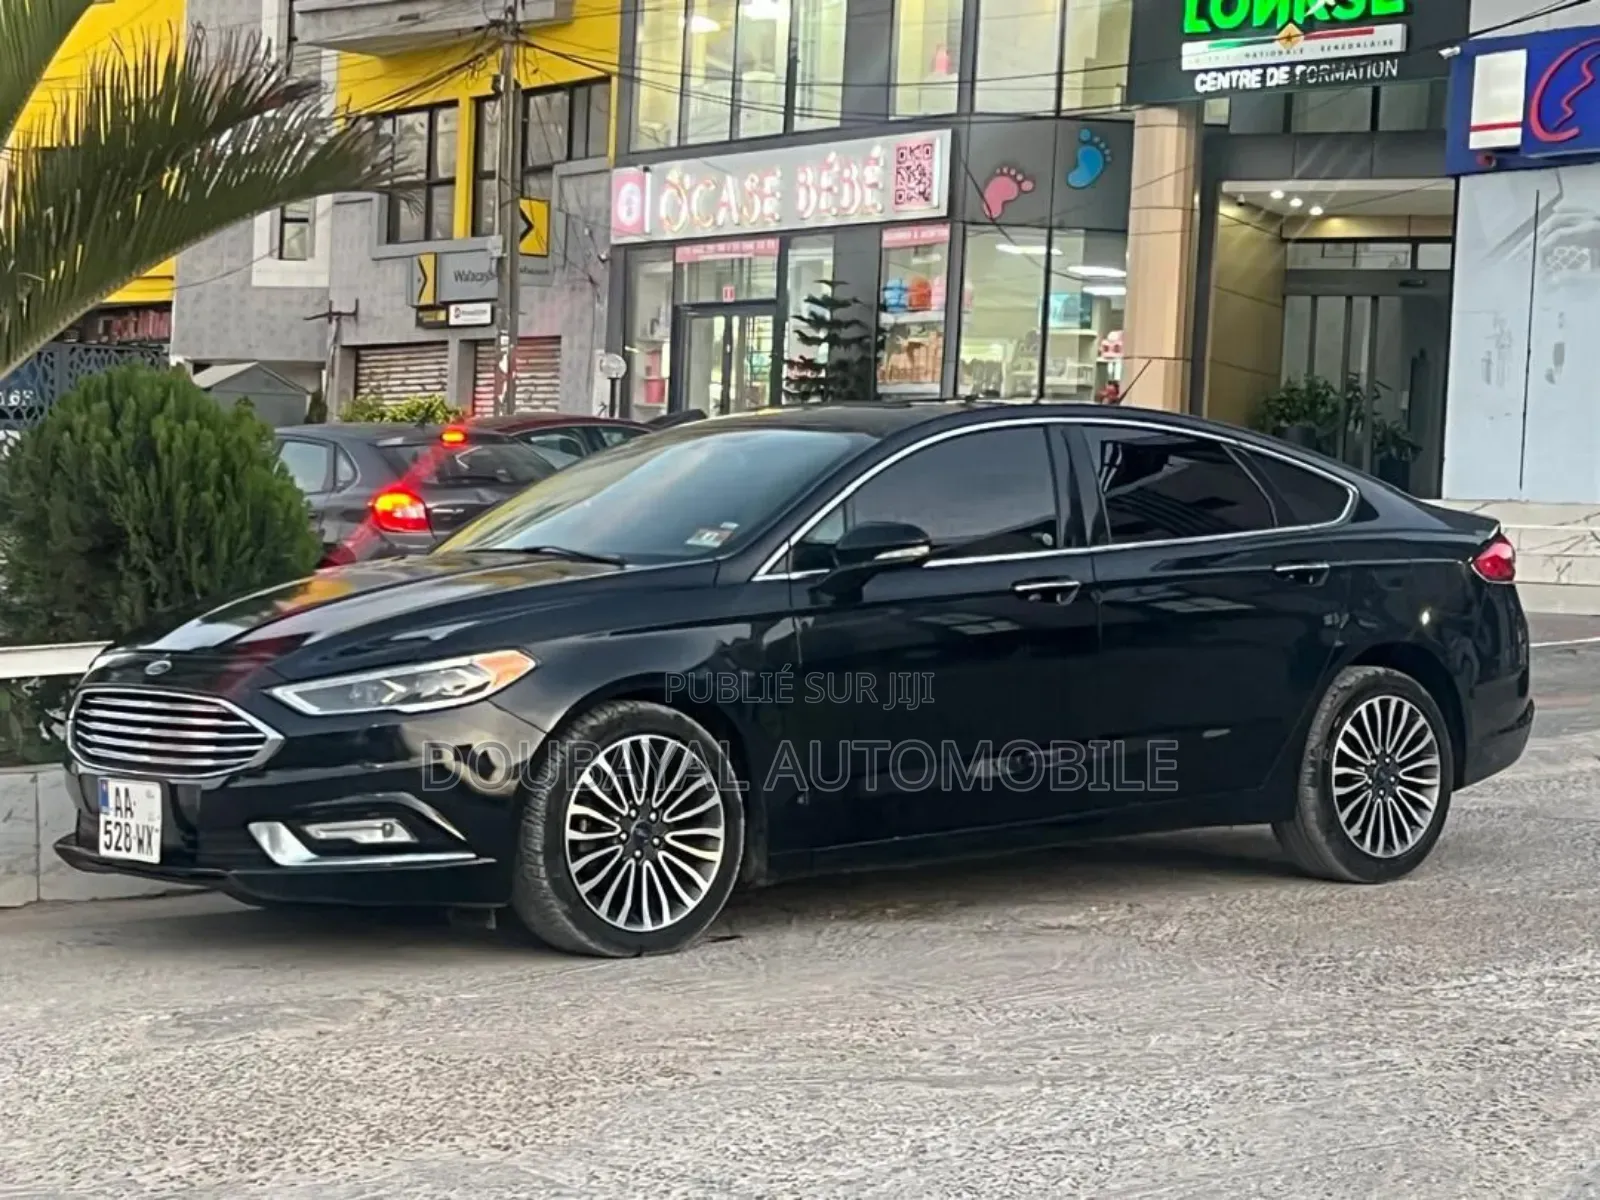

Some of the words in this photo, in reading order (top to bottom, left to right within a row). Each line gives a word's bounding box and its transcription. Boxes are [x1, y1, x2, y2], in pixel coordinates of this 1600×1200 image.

[1194, 68, 1263, 93] CENTRE
[1265, 66, 1290, 87] DE
[1295, 58, 1399, 84] FORMATION
[115, 787, 134, 818] AA
